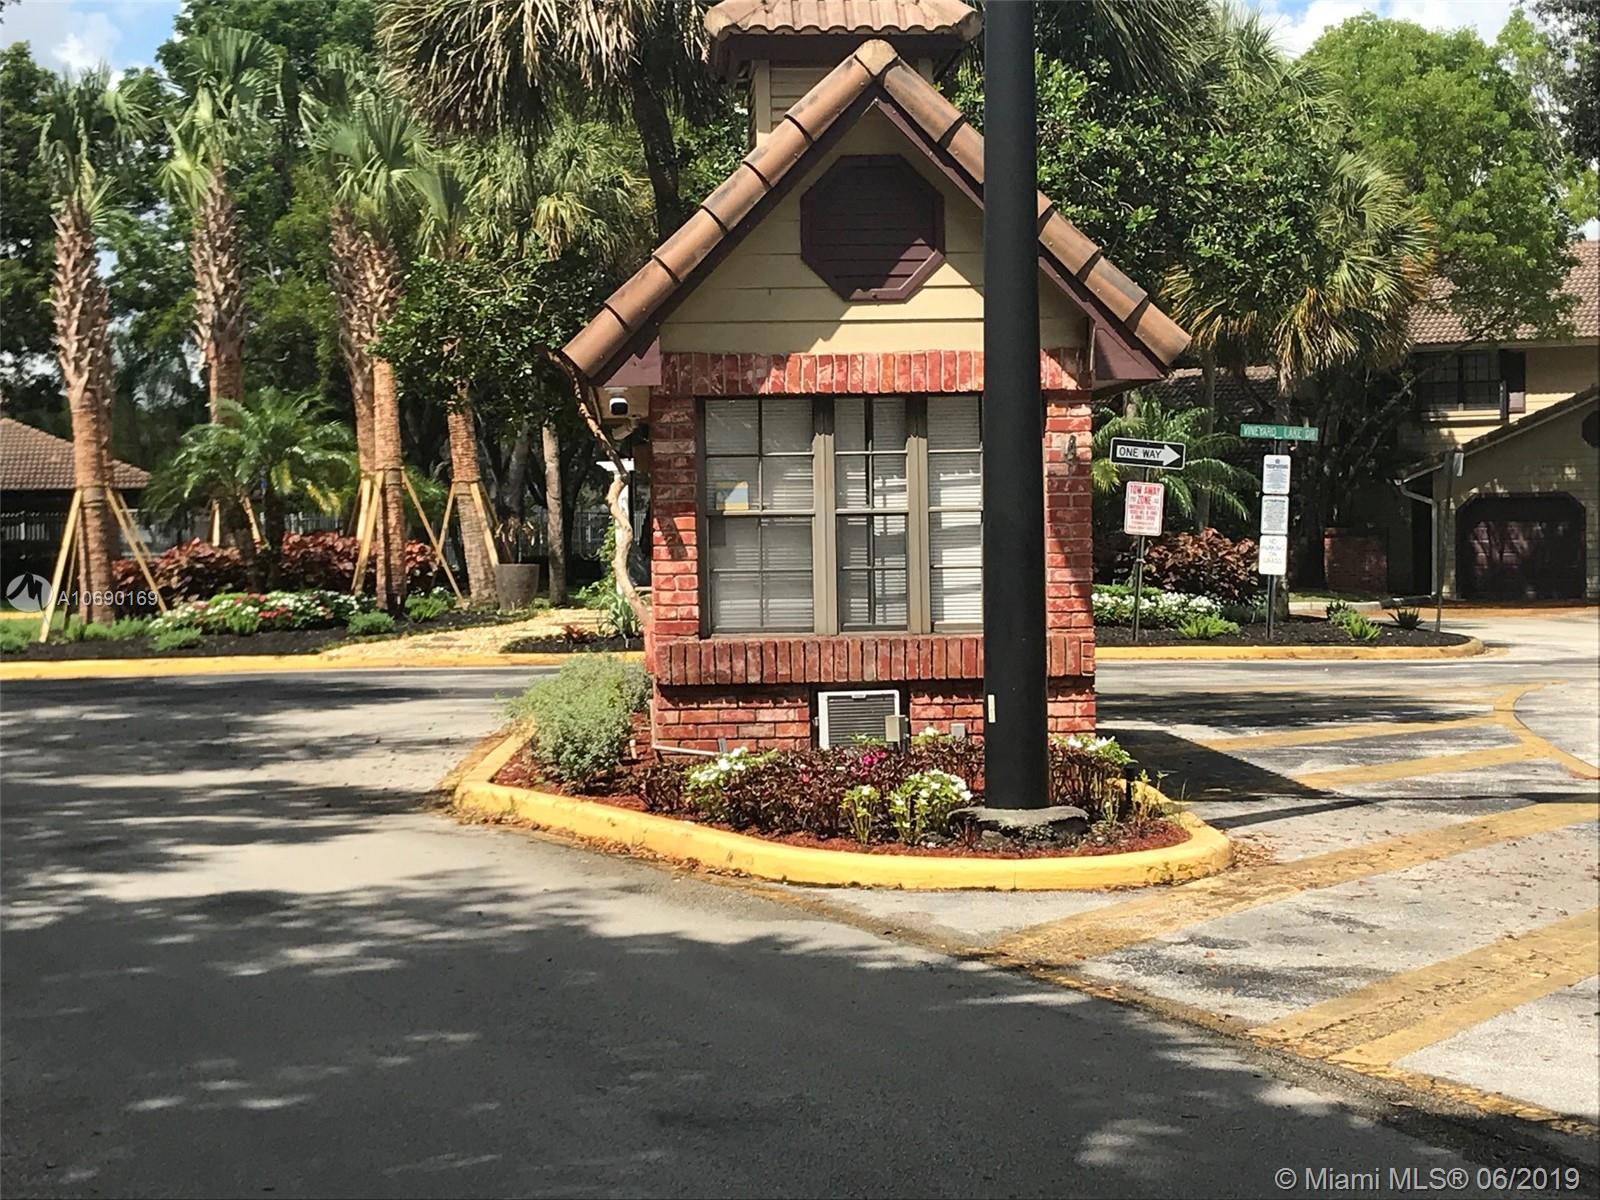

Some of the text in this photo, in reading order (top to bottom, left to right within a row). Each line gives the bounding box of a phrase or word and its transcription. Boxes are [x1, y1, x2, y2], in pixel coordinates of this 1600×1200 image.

[1243, 425, 1316, 440] VINEYARD LAKE DR
[1119, 446, 1162, 459] ONE WAY
[1130, 485, 1160, 495] TOW AWAY
[1137, 495, 1151, 504] ZONE
